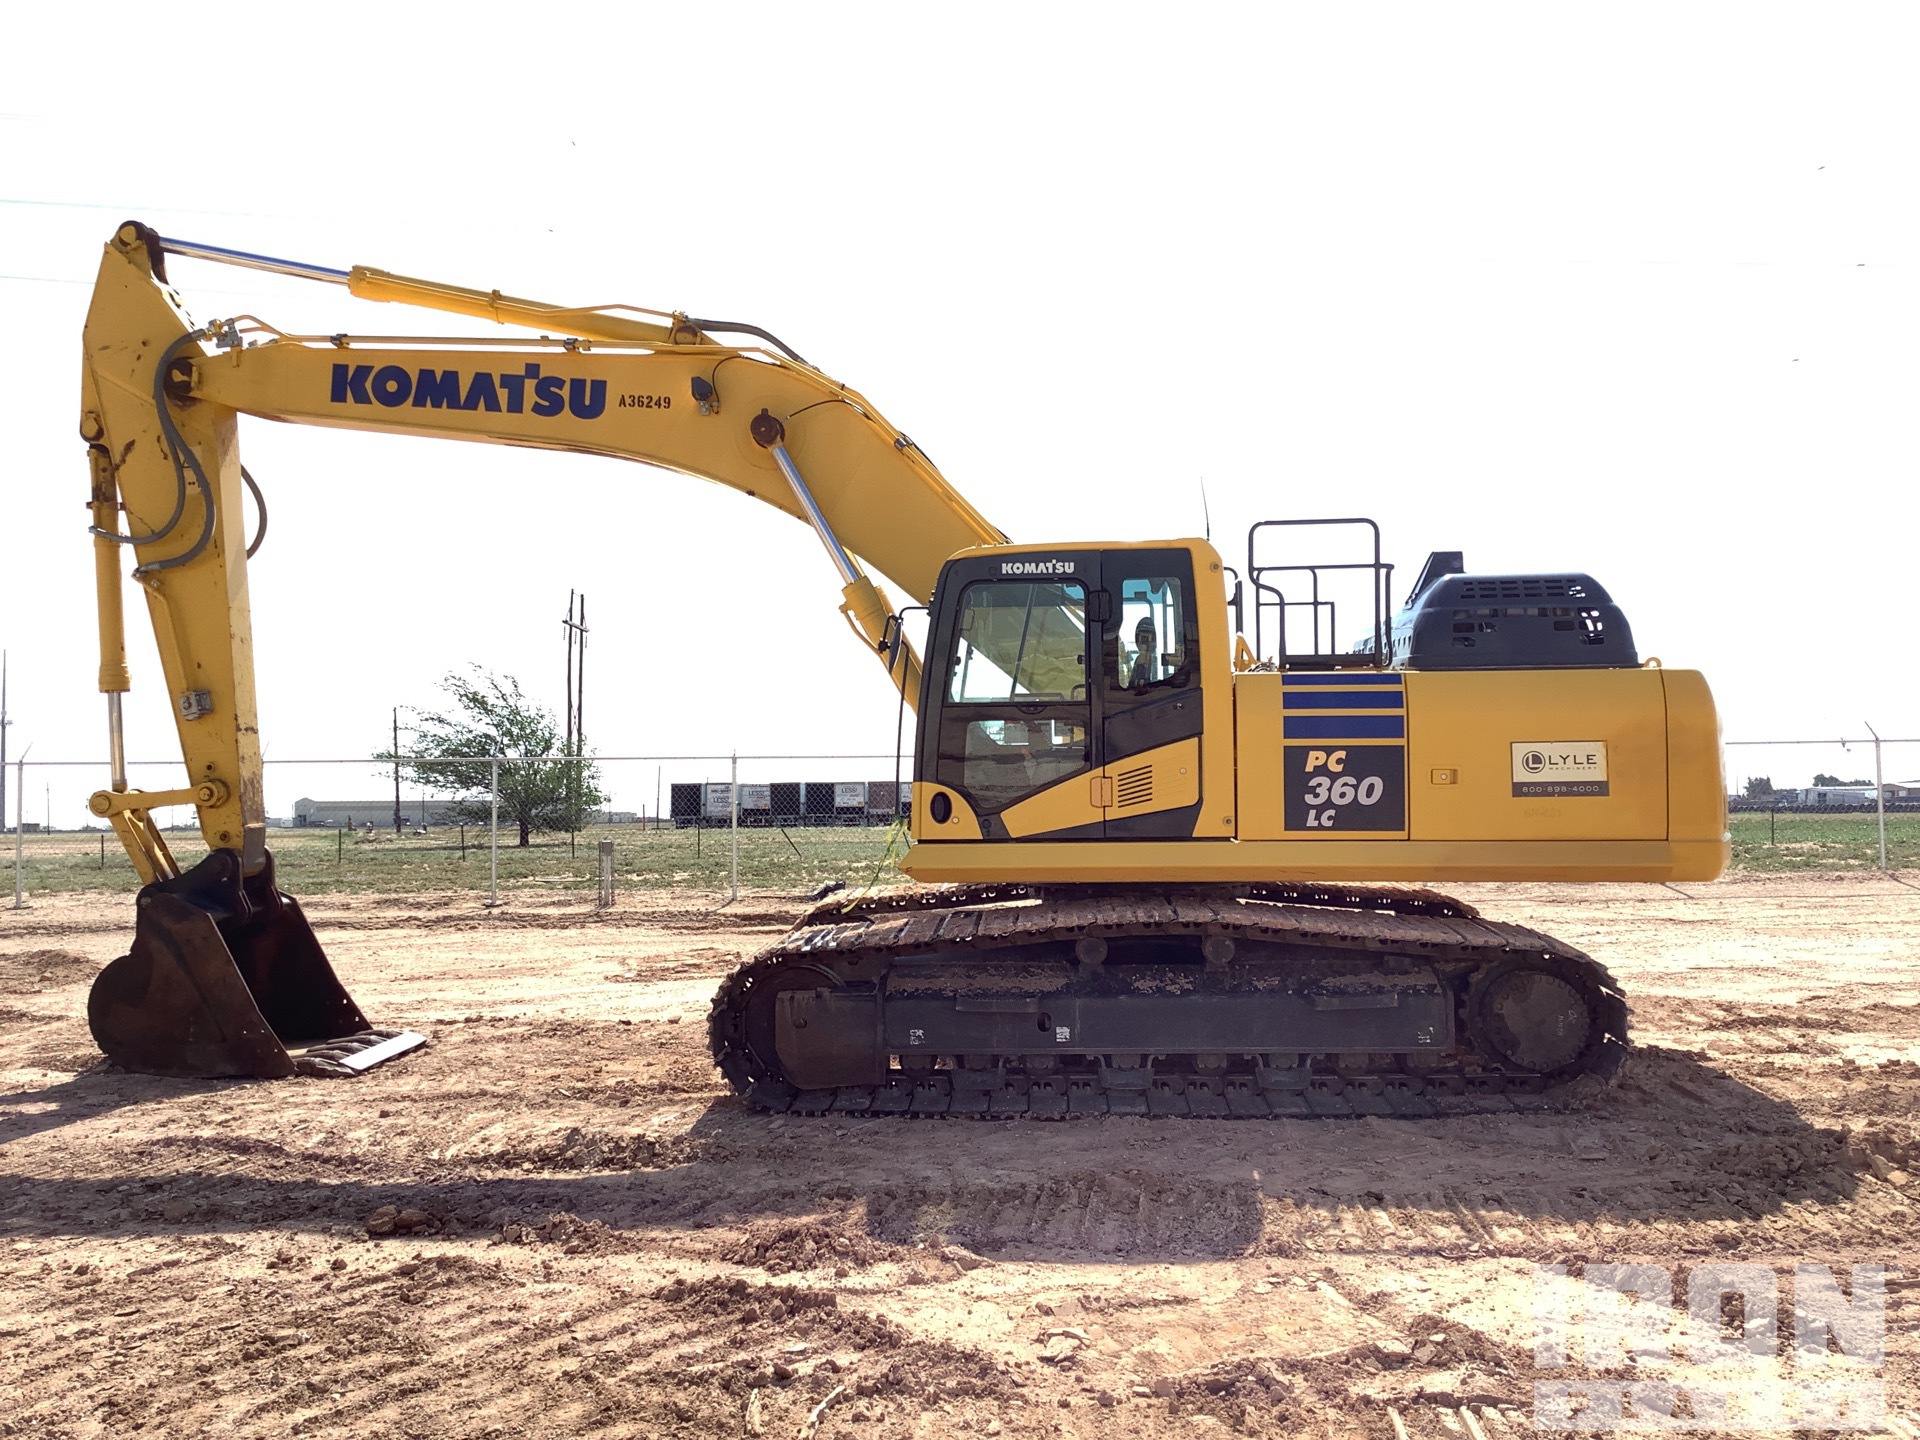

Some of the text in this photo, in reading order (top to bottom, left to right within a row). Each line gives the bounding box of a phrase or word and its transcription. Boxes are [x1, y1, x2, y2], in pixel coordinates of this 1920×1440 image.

[330, 362, 607, 420] KOMATSU
[617, 394, 671, 410] A36249
[1001, 559, 1075, 574] KOMATSU
[1304, 750, 1347, 773] PC
[1548, 754, 1597, 765] LYLE
[1304, 776, 1384, 806] 360
[1522, 785, 1600, 793] 800-898-4000
[1305, 809, 1336, 827] LC
